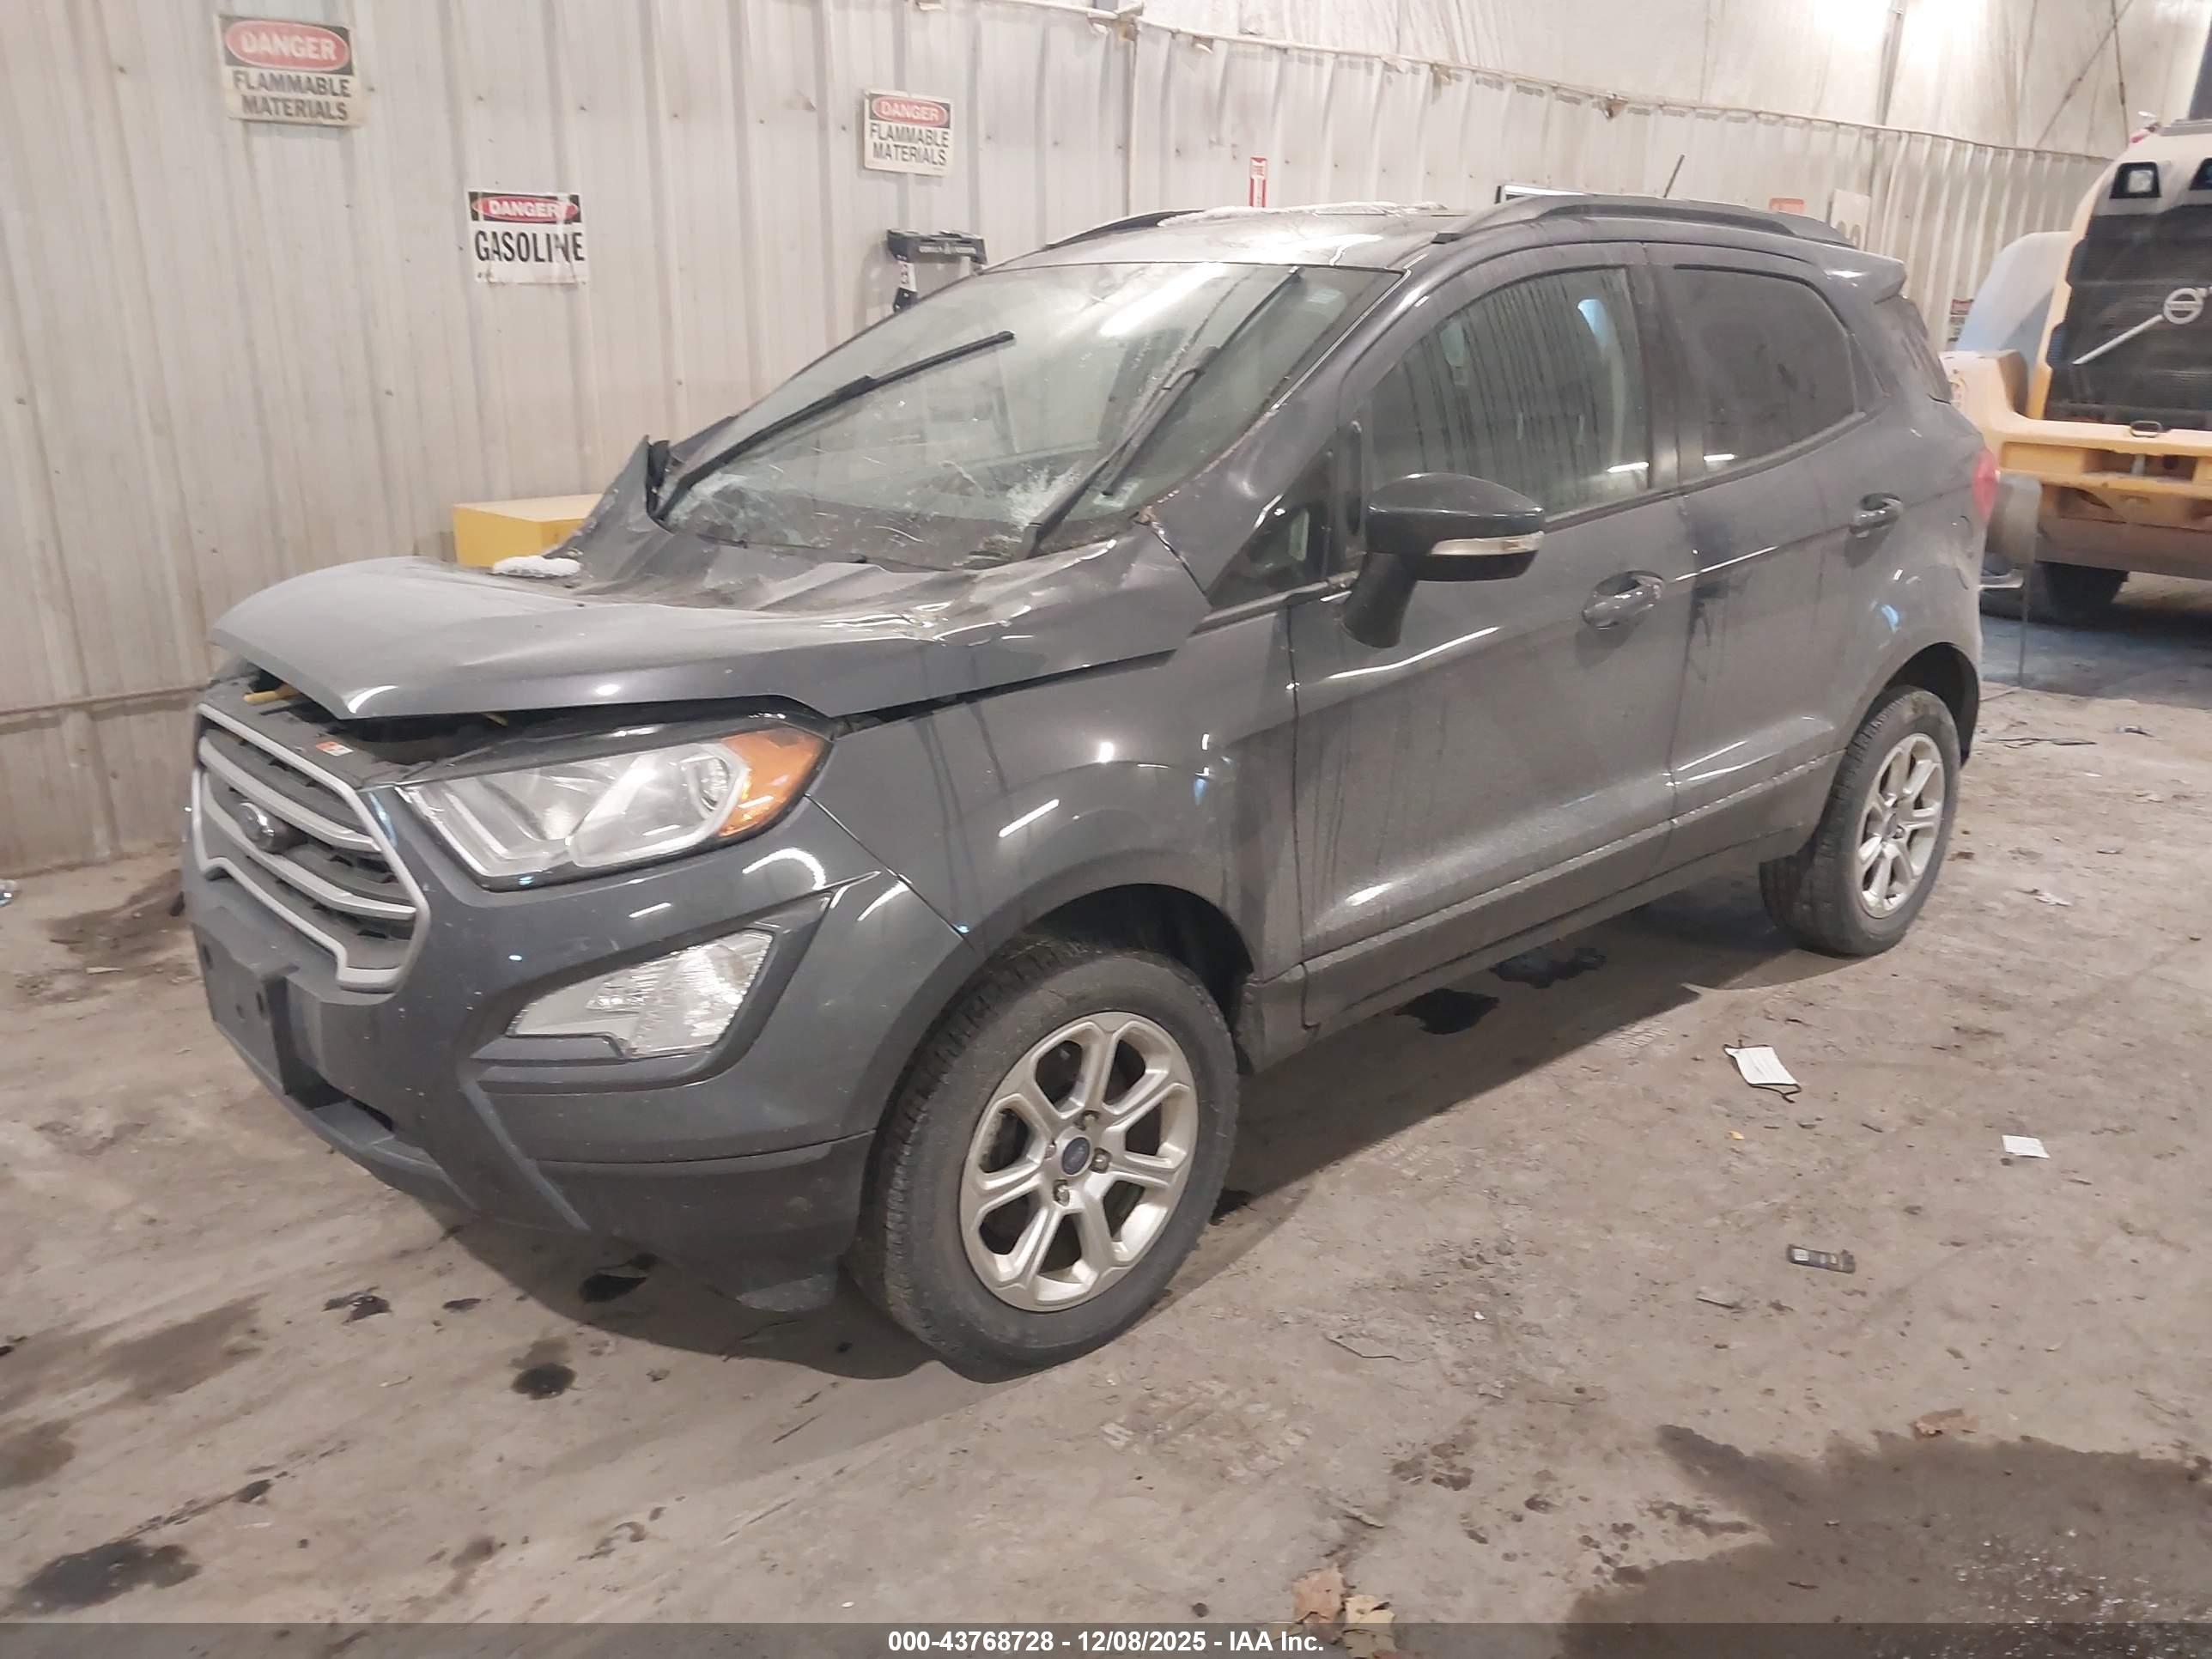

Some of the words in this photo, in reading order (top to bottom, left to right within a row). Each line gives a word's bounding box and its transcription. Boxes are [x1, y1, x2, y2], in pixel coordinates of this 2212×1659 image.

[240, 31, 337, 61] DANGER
[233, 70, 352, 97] FLAMMABLE
[241, 94, 349, 121] MATERIALS
[880, 100, 940, 121] DANGER
[870, 122, 949, 148] FLAMMABLE
[872, 142, 946, 166] MATERIALS
[488, 199, 562, 218] DANGER
[474, 230, 586, 263] GASOLINE
